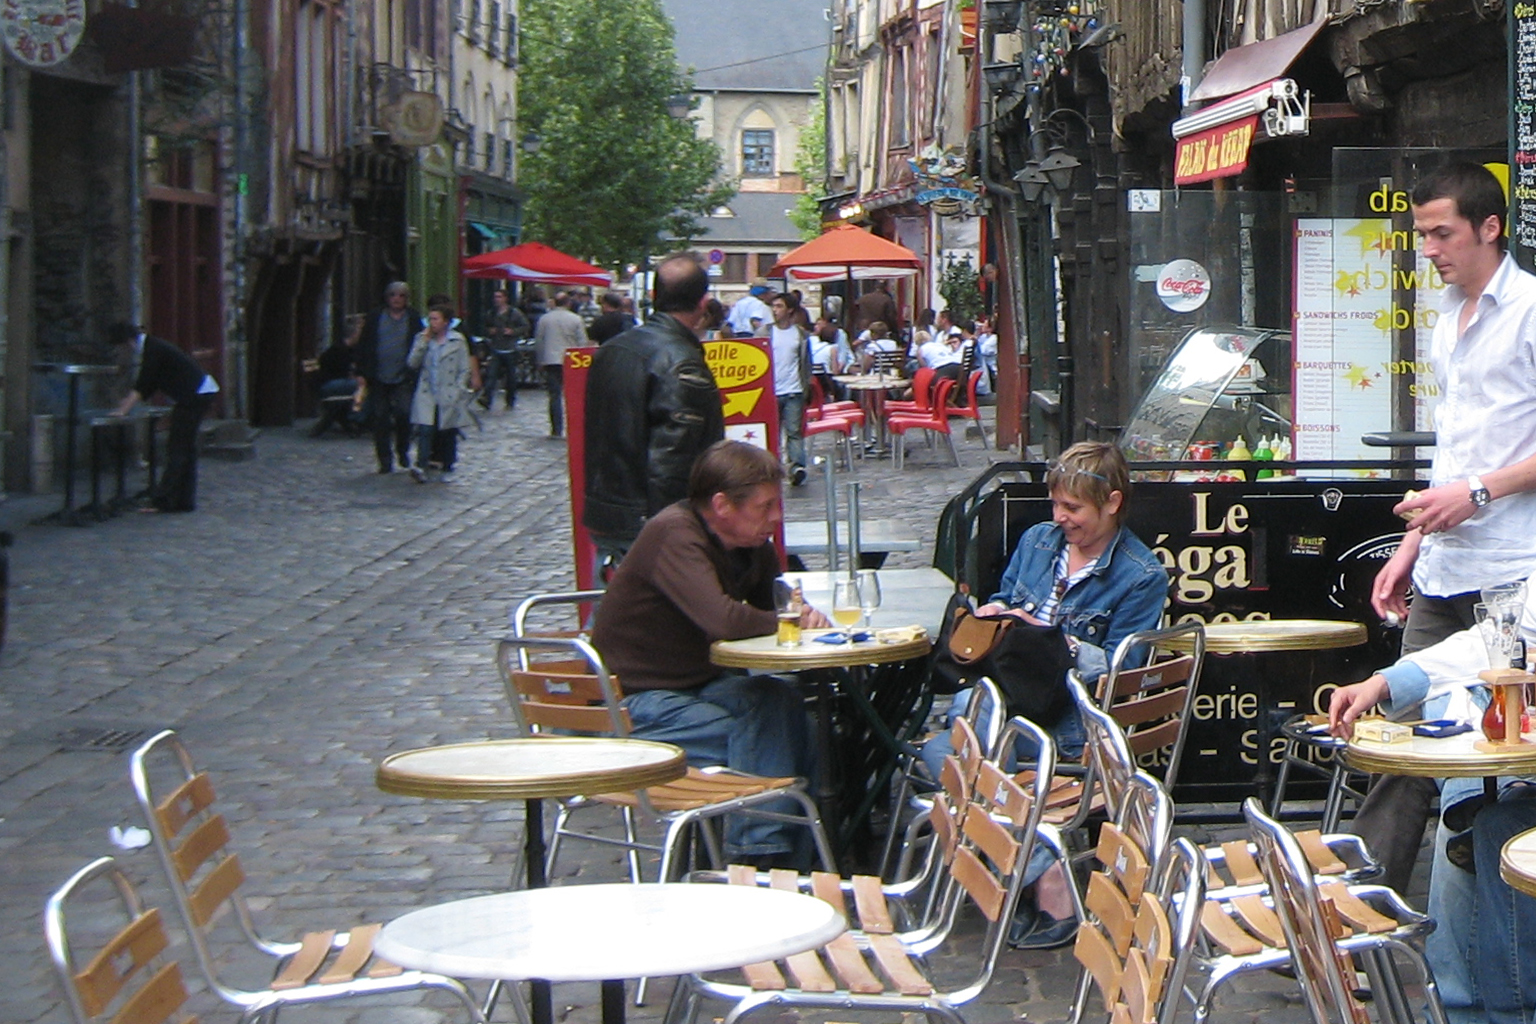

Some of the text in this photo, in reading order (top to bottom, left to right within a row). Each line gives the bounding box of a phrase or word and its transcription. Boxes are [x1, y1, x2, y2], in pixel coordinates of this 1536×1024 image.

[1303, 229, 1333, 238] PANINIS
[1303, 311, 1379, 320] SANDWICHS FROIDS
[704, 344, 738, 361] alle
[1302, 361, 1352, 371] BARQUETTES
[1302, 424, 1341, 433] BOISSONS
[1191, 492, 1249, 534] Le
